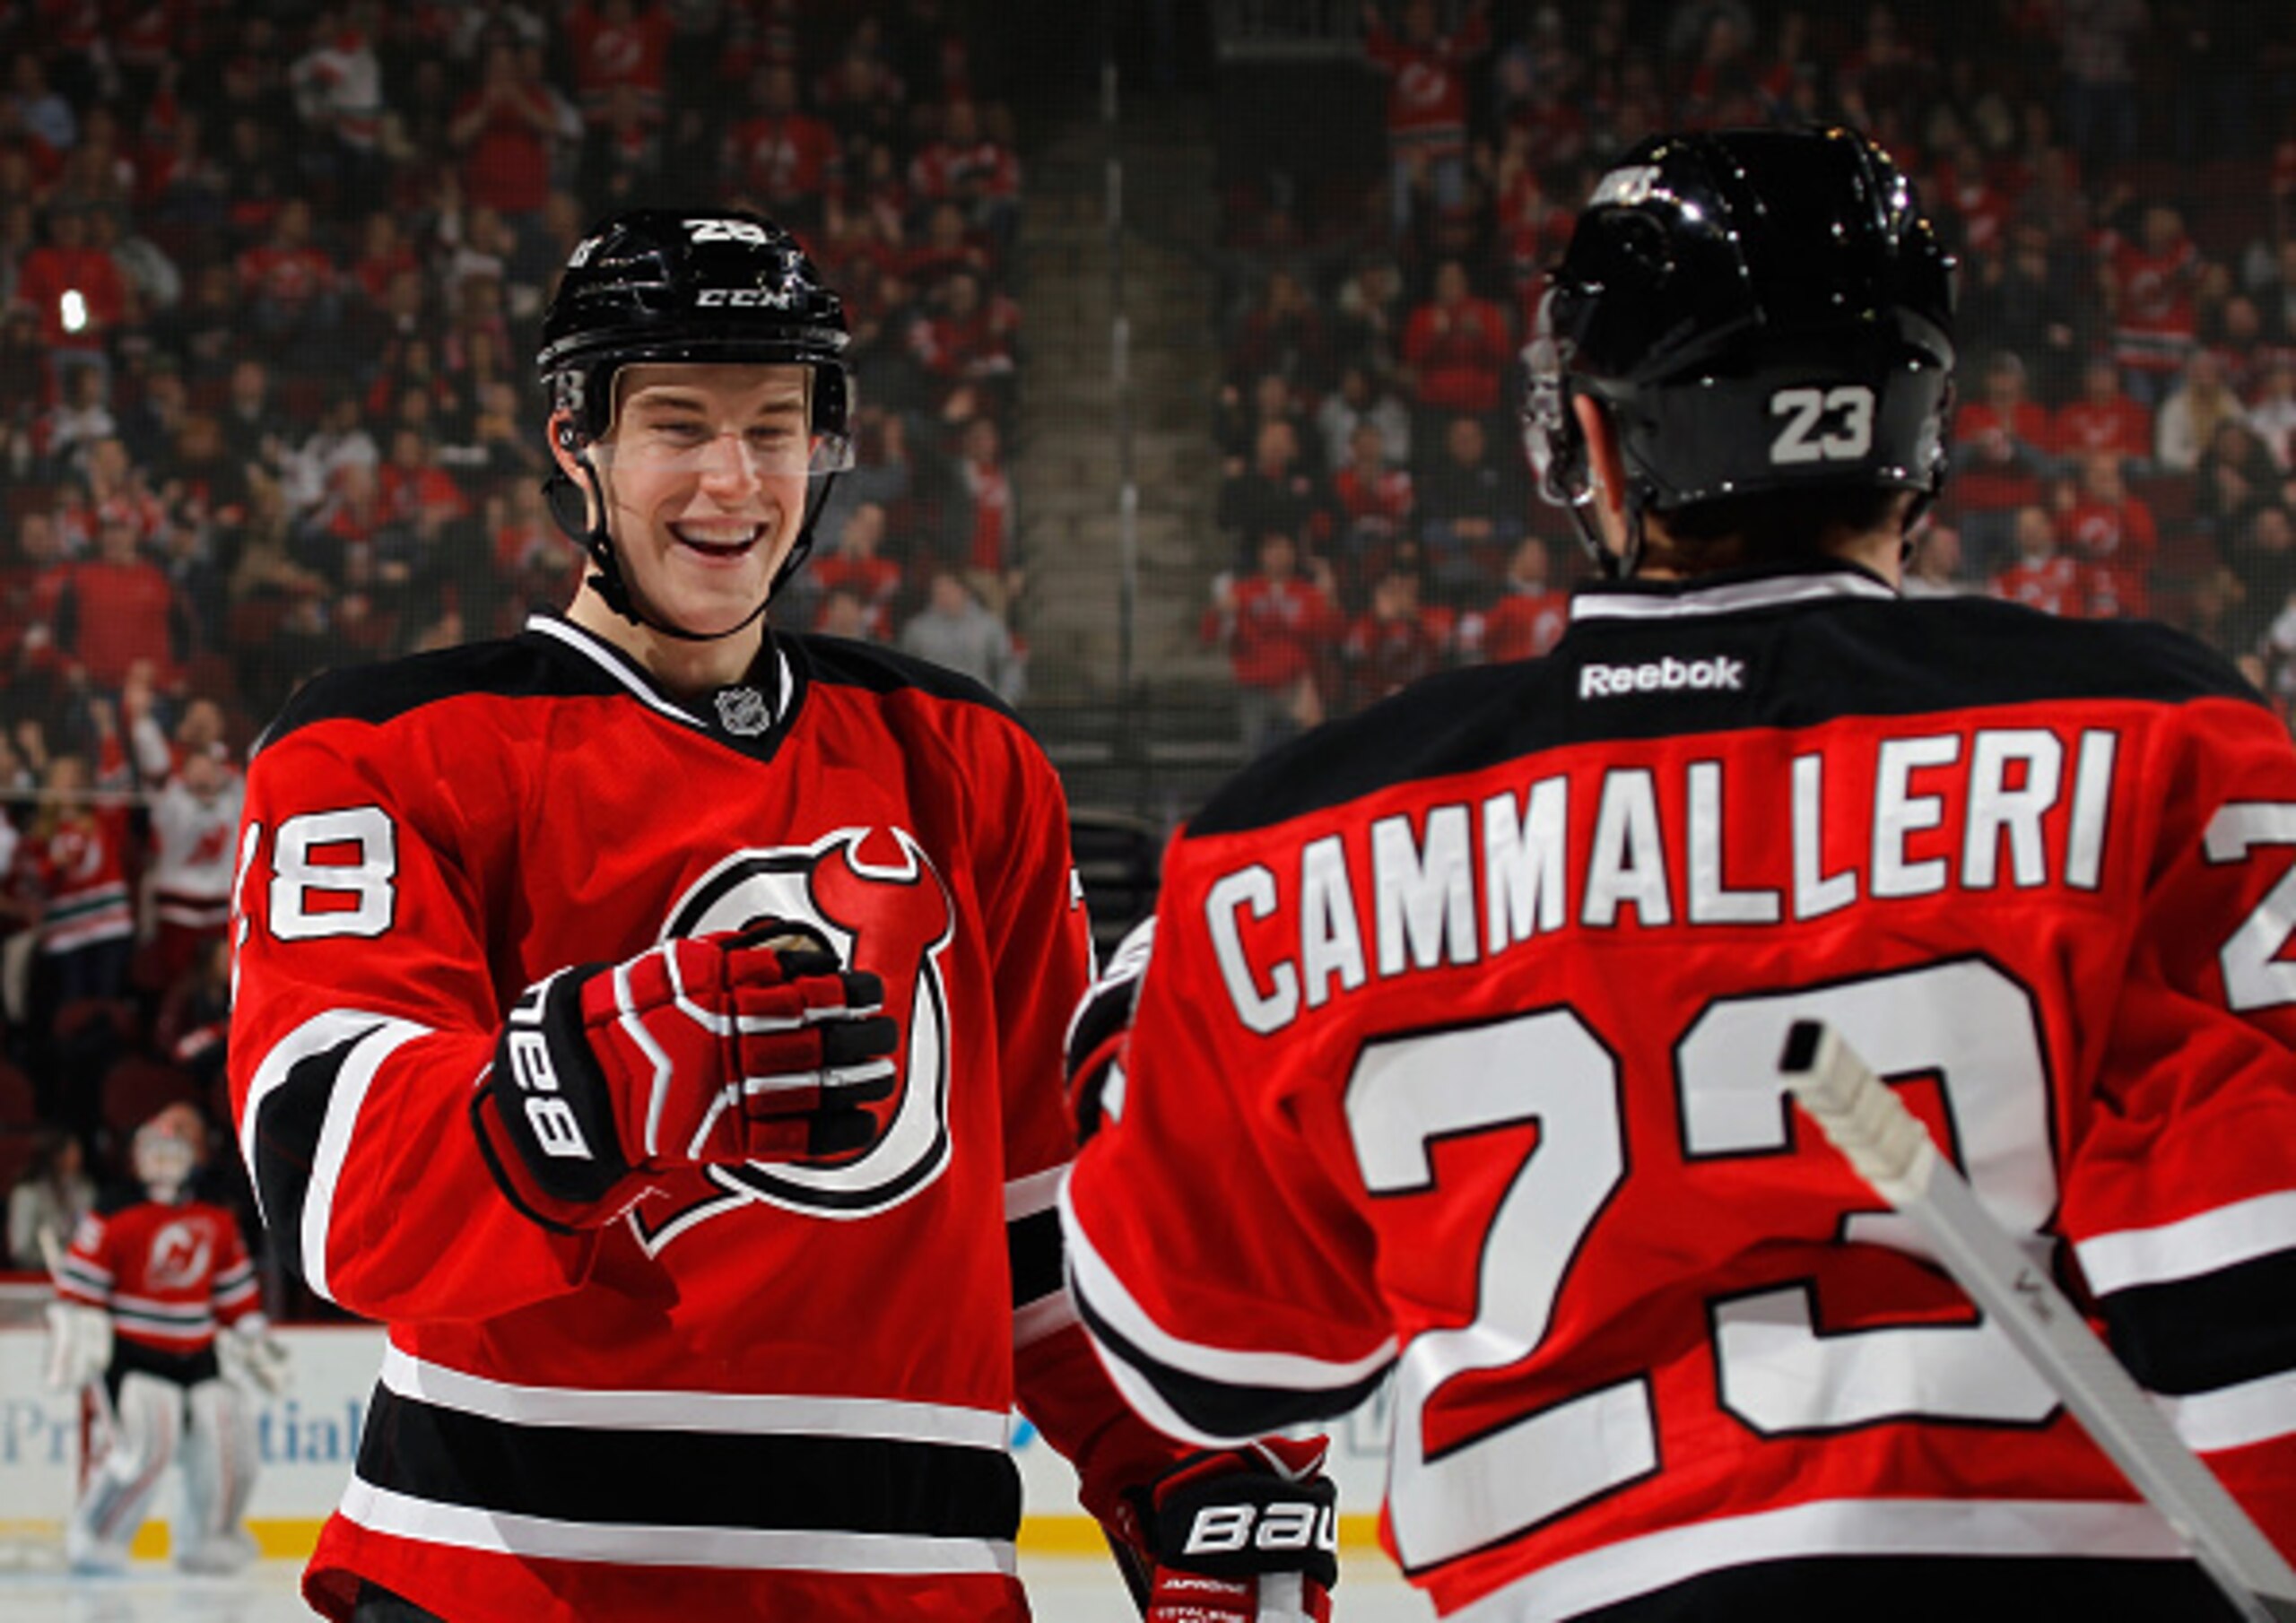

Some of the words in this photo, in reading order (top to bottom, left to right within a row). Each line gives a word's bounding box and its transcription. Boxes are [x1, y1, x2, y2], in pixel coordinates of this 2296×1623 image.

[696, 289, 790, 310] CCM
[1769, 386, 1876, 464] 23
[1579, 655, 1744, 699] Reebok
[235, 804, 397, 942] 8
[1204, 725, 2118, 1037] CAMMALLERI
[1344, 958, 2065, 1575] 23
